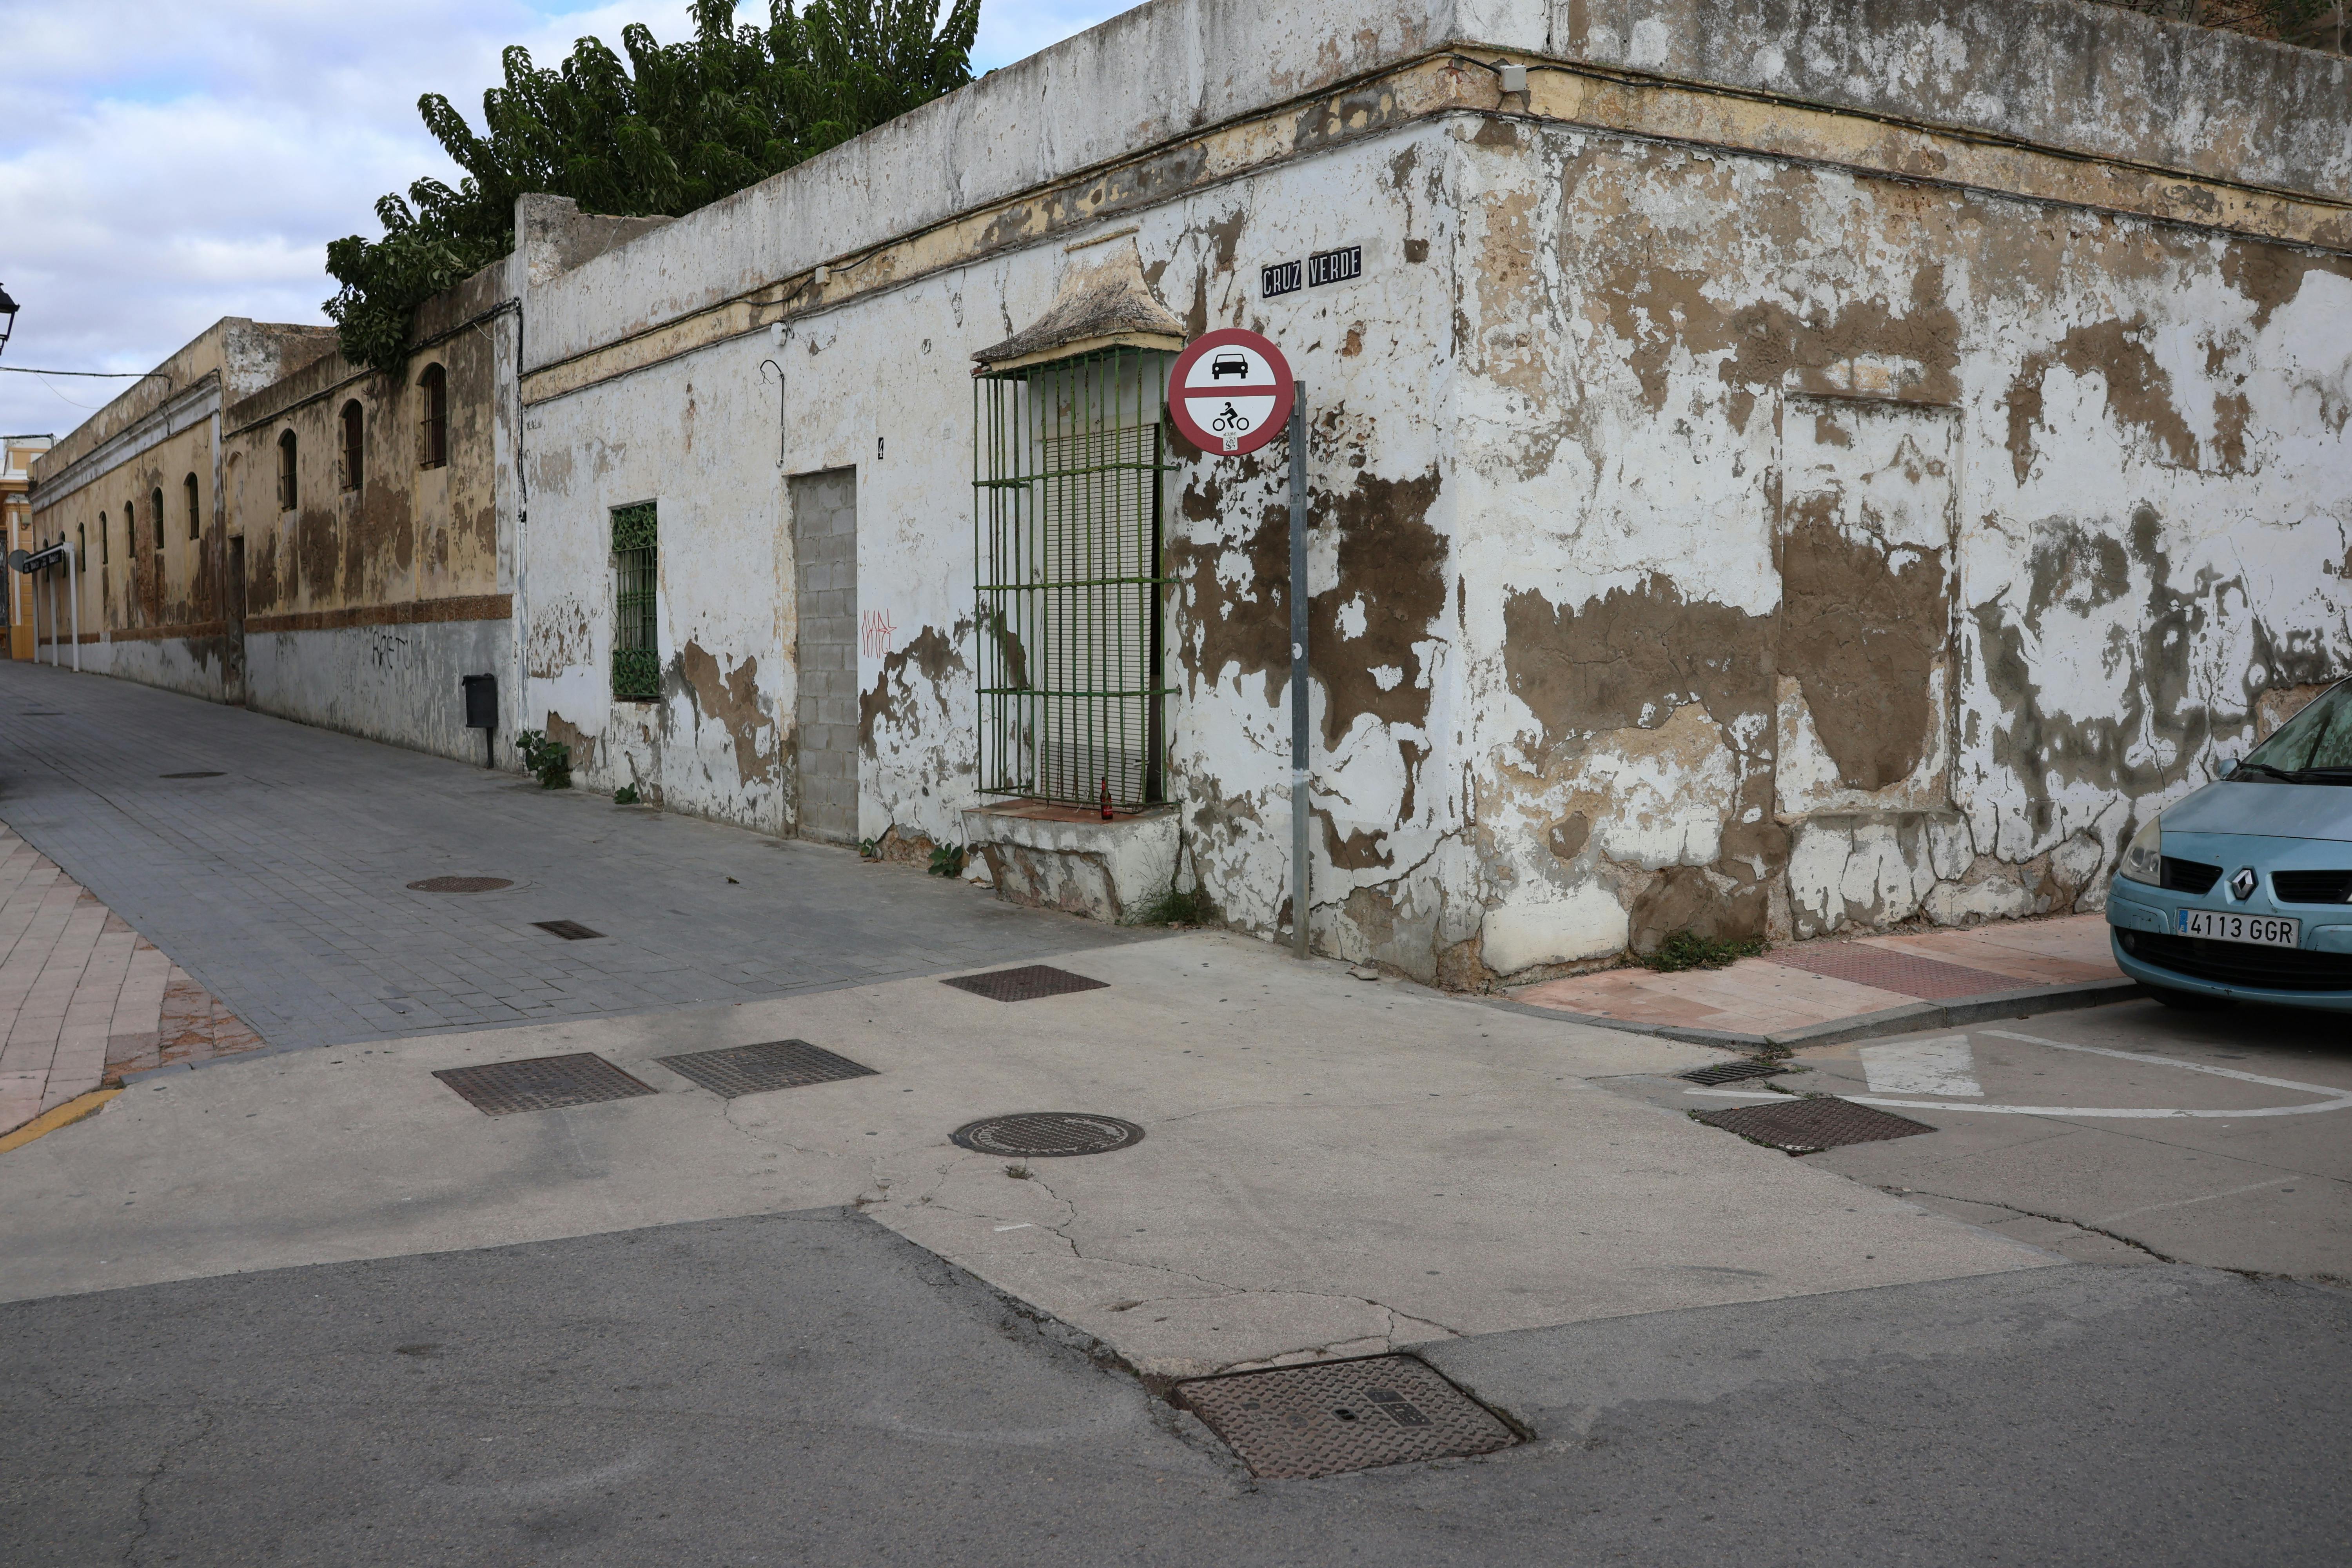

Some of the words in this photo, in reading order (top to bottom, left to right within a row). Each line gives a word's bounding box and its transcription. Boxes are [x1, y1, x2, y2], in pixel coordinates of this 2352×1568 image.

[1263, 263, 1300, 295] CRUZ
[1309, 249, 1359, 284] VERDE
[878, 439, 883, 458] 4
[2191, 914, 2242, 938] 4113
[2250, 919, 2292, 944] GGR
